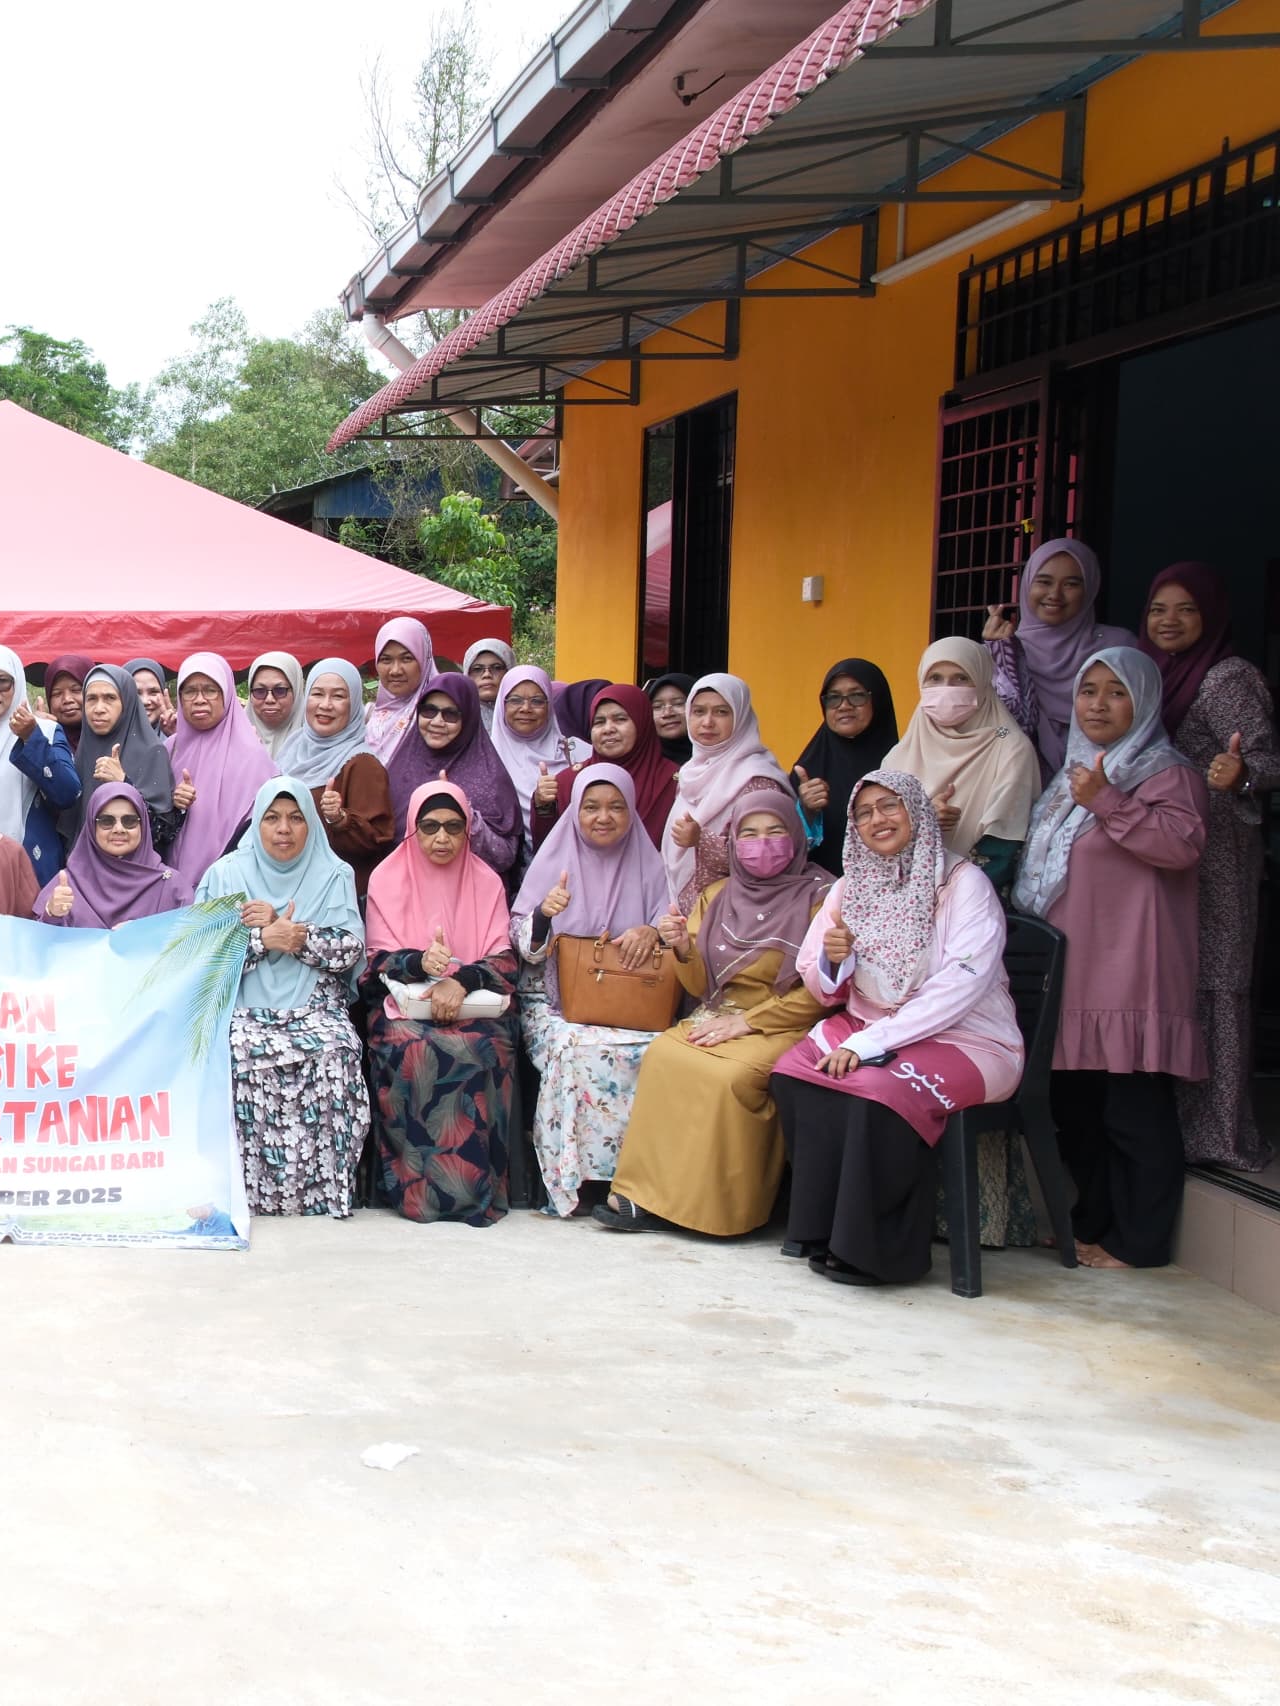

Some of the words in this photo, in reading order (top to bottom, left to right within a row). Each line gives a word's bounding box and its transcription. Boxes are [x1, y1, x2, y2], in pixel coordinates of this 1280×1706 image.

[26, 1043, 79, 1088] KE
[22, 1154, 106, 1174] SUNGAI
[110, 1151, 165, 1171] BARI
[56, 1186, 123, 1206] 2025
